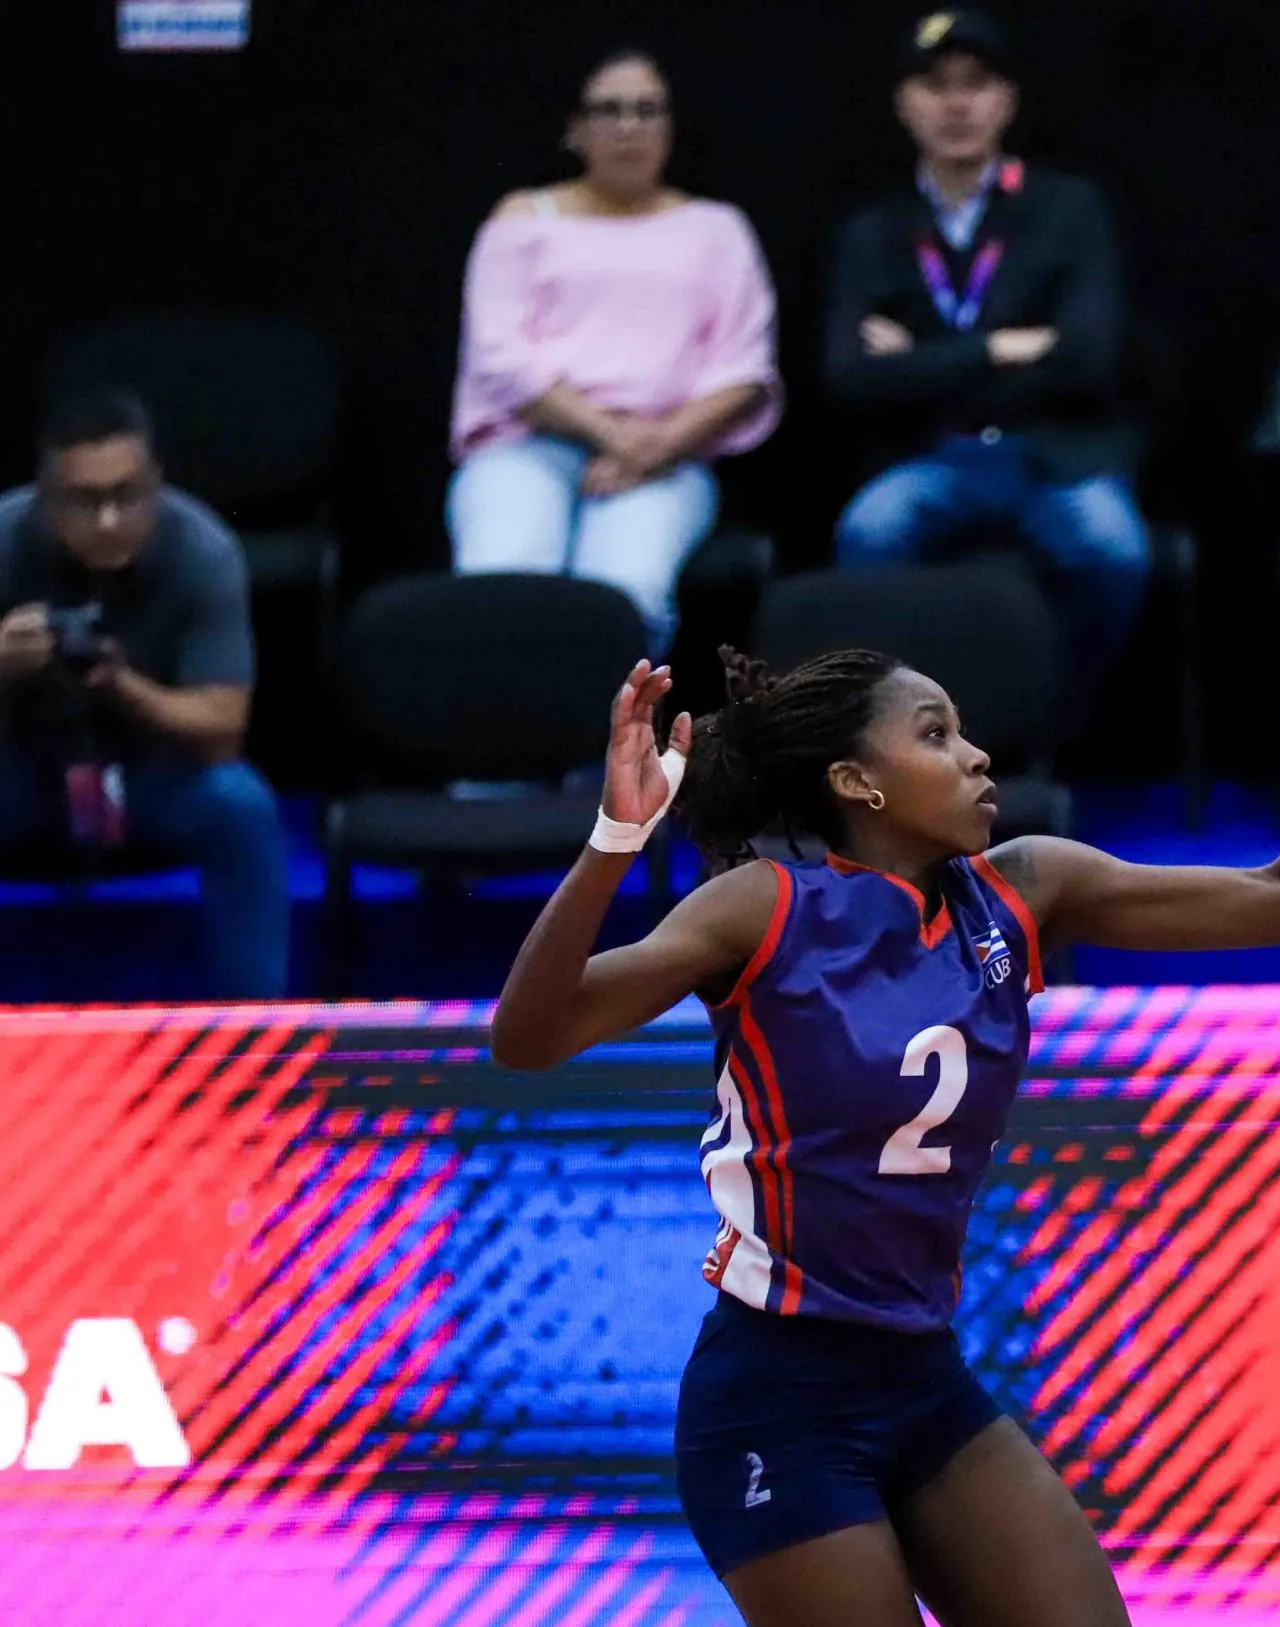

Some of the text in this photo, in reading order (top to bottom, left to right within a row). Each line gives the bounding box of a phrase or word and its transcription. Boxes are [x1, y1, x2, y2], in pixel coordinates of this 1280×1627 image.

[985, 957, 1012, 990] CUB
[877, 1024, 969, 1175] 2
[0, 1317, 193, 1471] A
[745, 1451, 772, 1509] 2
